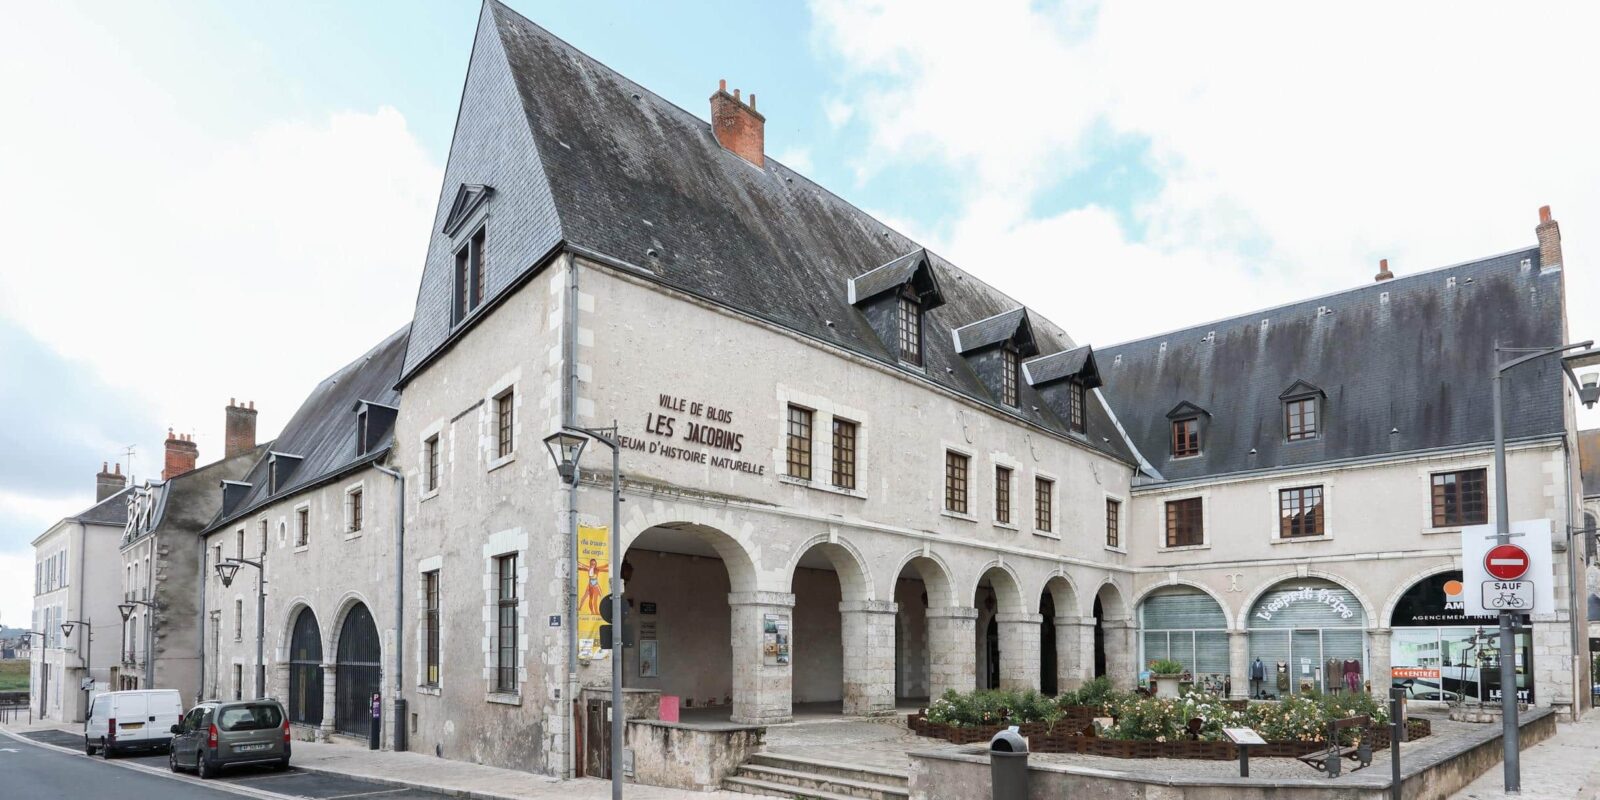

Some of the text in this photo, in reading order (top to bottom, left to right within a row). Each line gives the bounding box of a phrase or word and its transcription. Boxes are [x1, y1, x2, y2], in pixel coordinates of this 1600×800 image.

[659, 393, 733, 424] VILLE DE BLOIS
[646, 412, 744, 453] LES JACOBINS
[598, 430, 765, 476] SEUM D'HISTOIRE NATURELLE
[1494, 582, 1522, 590] SAUF
[1444, 602, 1464, 610] AM
[1408, 670, 1439, 678] ENTRÉE
[1489, 689, 1530, 699] LEHT
